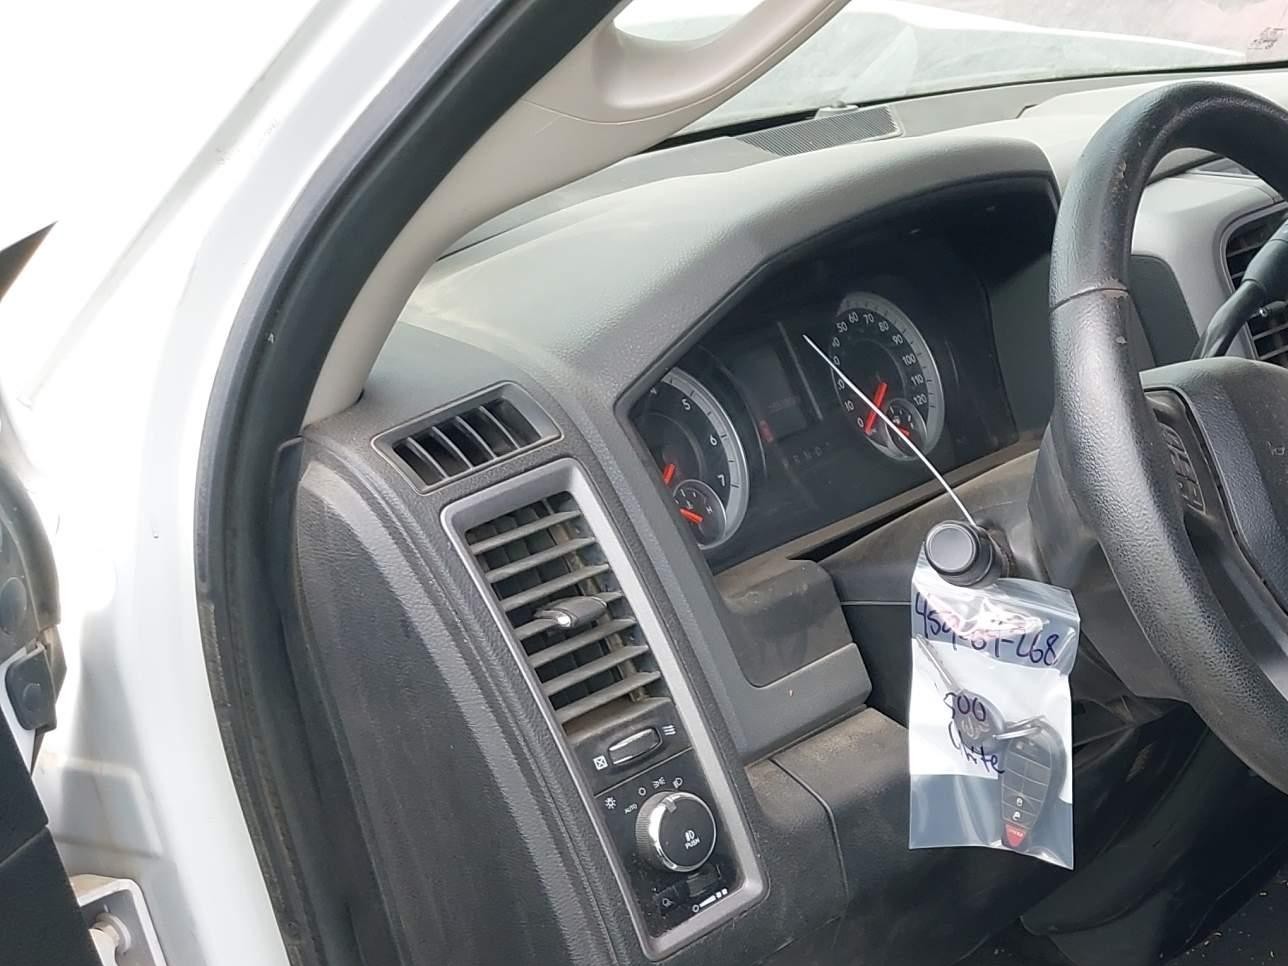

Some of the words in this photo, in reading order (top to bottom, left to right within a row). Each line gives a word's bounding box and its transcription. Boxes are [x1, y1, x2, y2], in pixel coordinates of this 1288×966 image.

[848, 312, 859, 324] 60
[863, 313, 874, 324] 70
[837, 321, 848, 333] 50
[878, 321, 889, 332] 80
[892, 334, 904, 345] 90
[902, 353, 916, 365] 100
[911, 374, 924, 385] 110
[682, 398, 691, 410] 5
[913, 394, 927, 405] 120
[844, 401, 855, 412] 10
[857, 418, 865, 428] 0
[710, 435, 718, 446] 6
[717, 474, 725, 487] 7
[685, 837, 700, 849] PUSH
